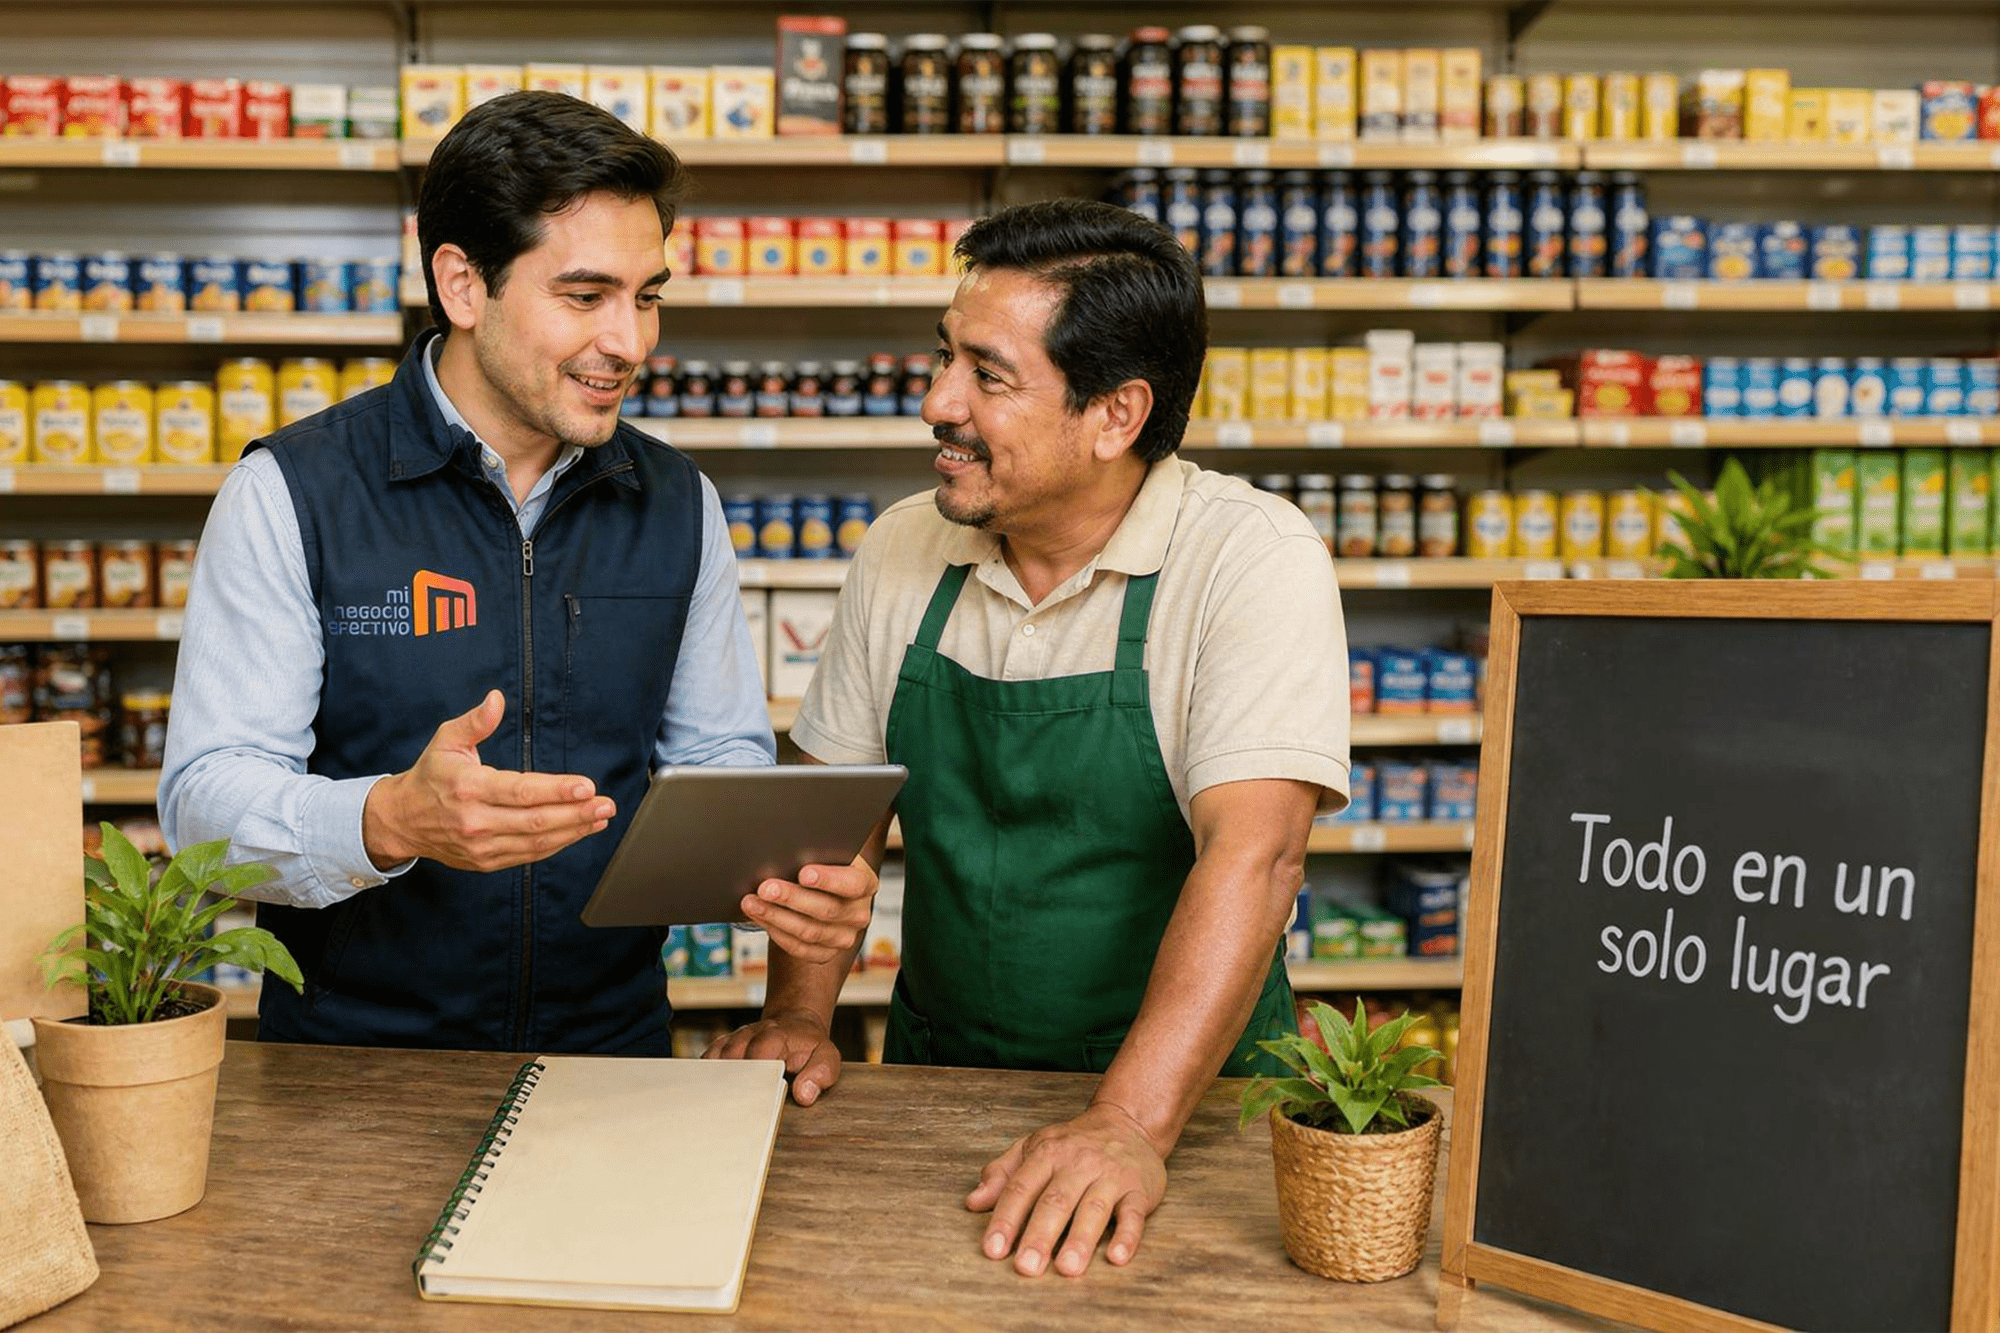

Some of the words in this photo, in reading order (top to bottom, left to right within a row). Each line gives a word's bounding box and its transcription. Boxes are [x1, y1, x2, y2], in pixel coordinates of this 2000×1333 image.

[386, 586, 409, 604] mi
[1570, 812, 1707, 895] Todo
[1732, 851, 1807, 908] en
[1834, 862, 1916, 921] un
[1597, 907, 1707, 984] solo
[1731, 915, 1891, 1024] lugar
